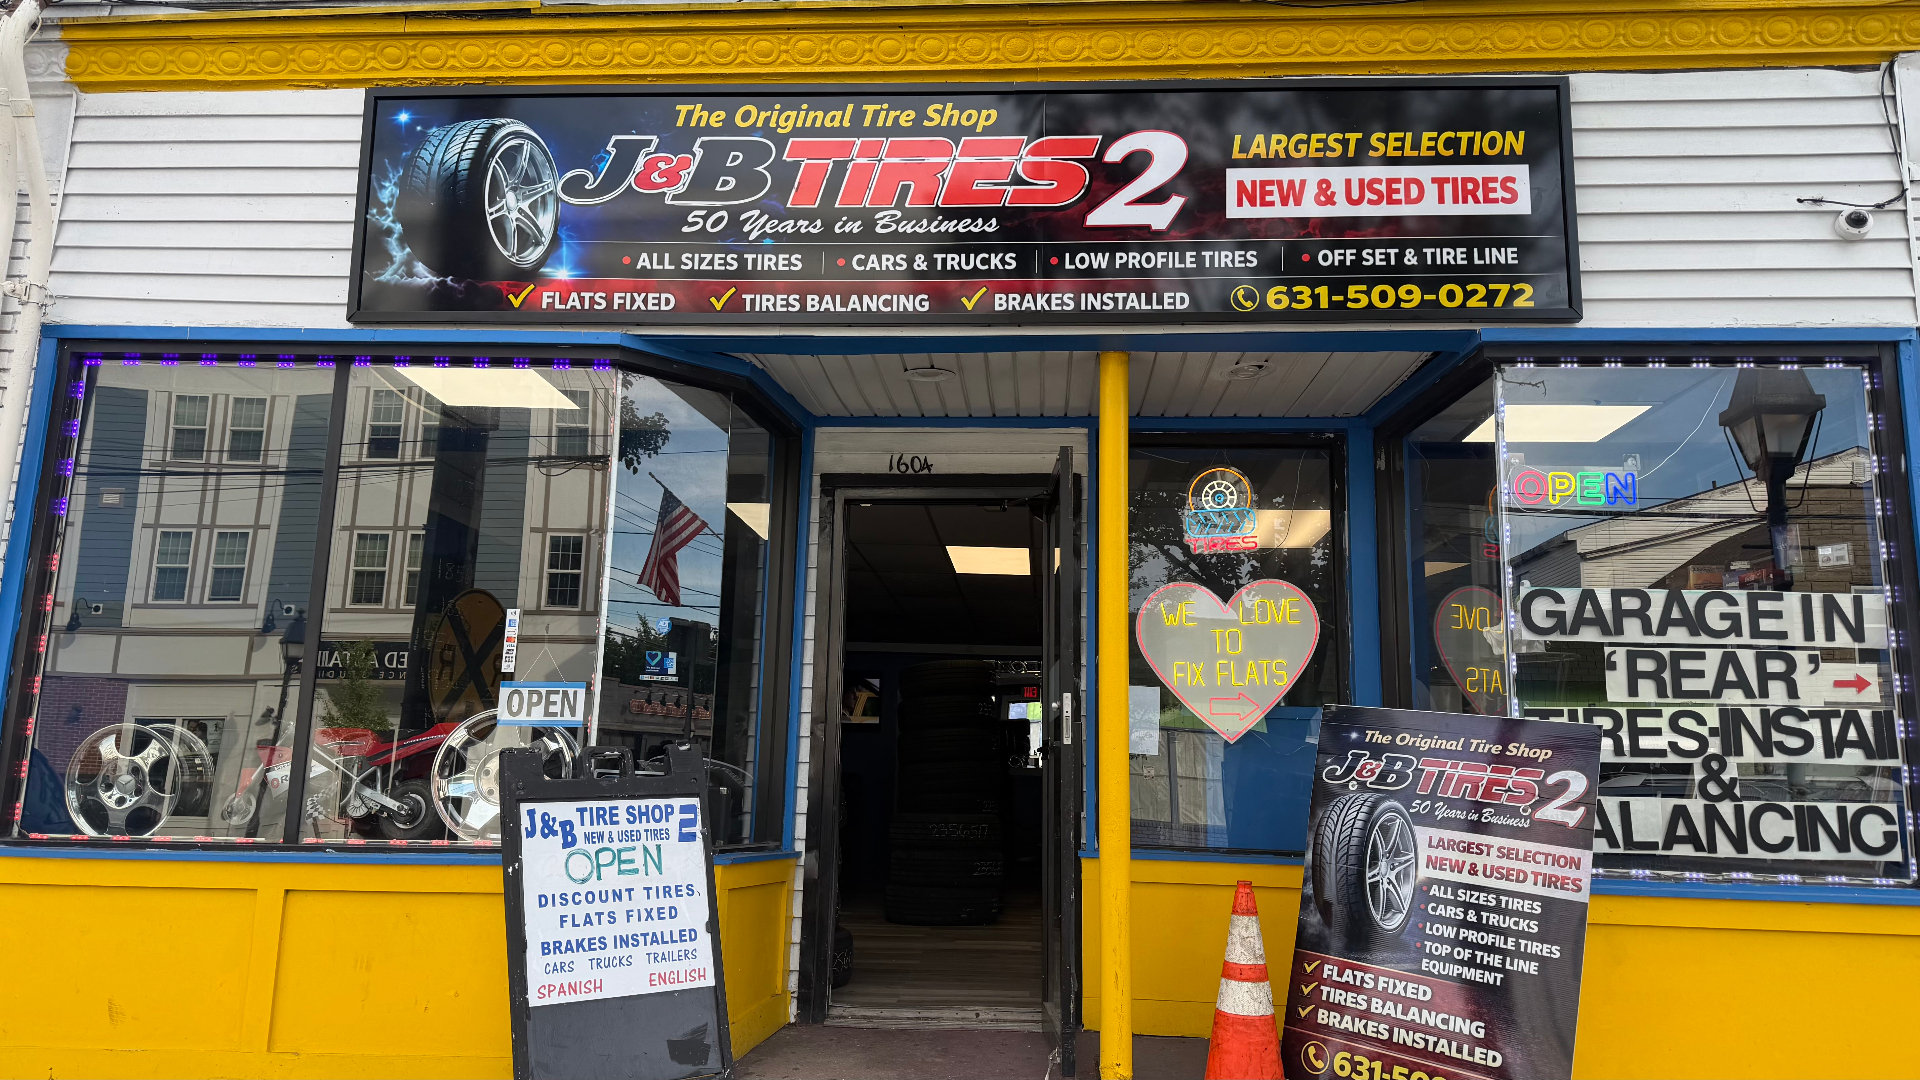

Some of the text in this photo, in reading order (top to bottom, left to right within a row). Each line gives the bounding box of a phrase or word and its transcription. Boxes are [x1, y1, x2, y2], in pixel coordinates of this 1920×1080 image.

[675, 102, 998, 133] The Original Tire Shop
[1231, 130, 1526, 160] LARGEST SELECTION
[558, 129, 1189, 231] J&B TIRES 2
[1235, 175, 1520, 208] NEW & USED TIRES
[681, 210, 1000, 243] 50 Years in Business
[637, 253, 803, 272] ALL SIZES TIRES
[851, 252, 1017, 271] CARS & TRUCKS
[1064, 250, 1258, 270] LOW PROFILE TIRES
[1317, 247, 1519, 267] OFF SET & TIRE LINE
[541, 291, 676, 312] FLATS FIXED
[742, 293, 930, 313] TIRES BALANCING
[993, 291, 1190, 312] BRAKES INSTALLED
[1265, 281, 1536, 309] 631-509-0272
[1514, 470, 1636, 505] OPEN
[1184, 536, 1258, 553] TIRES
[1161, 597, 1301, 626] WE LOVE
[1520, 589, 1866, 643] GARAGE IN
[1211, 628, 1242, 654] TO
[1173, 660, 1288, 687] FIX FLATS
[506, 688, 577, 718] OPEN
[1364, 731, 1552, 762] The Original Tire Shop
[1323, 750, 1589, 829] J&B TIRES 2
[1698, 753, 1743, 802] &
[525, 808, 578, 850] J&B
[576, 806, 620, 827] TIRE
[625, 804, 675, 826] SHOP
[1409, 800, 1530, 828] 50 Years in Business
[584, 828, 671, 845] NEW & USED TIRES
[564, 843, 664, 885] OPEN
[1427, 835, 1582, 871] LARGEST SELECTION
[1425, 855, 1583, 893] NEW & USED TIRES
[538, 887, 635, 908] DISCOUNT
[1429, 884, 1542, 914] ALL SIZES TIRES
[559, 905, 678, 928] FLATS FIXED
[1427, 903, 1539, 933] CARS & TRUCKS
[541, 928, 698, 956] BRAKES INSTALLED
[1426, 922, 1561, 959] LOW PROFILE TIRES
[544, 949, 697, 975] CARS TRUCKS TRAILERS
[1422, 958, 1504, 987] EQUIPMENT
[1424, 941, 1539, 975] TOP OF THE LINE
[537, 967, 707, 999] SPANISH ENGLISH
[1322, 963, 1432, 1002] FLATS FIXED
[1320, 985, 1486, 1040] TIRES BALANCING
[1317, 1007, 1503, 1069] BRAKES INSTALLED
[1333, 1051, 1449, 1080] 631-5
